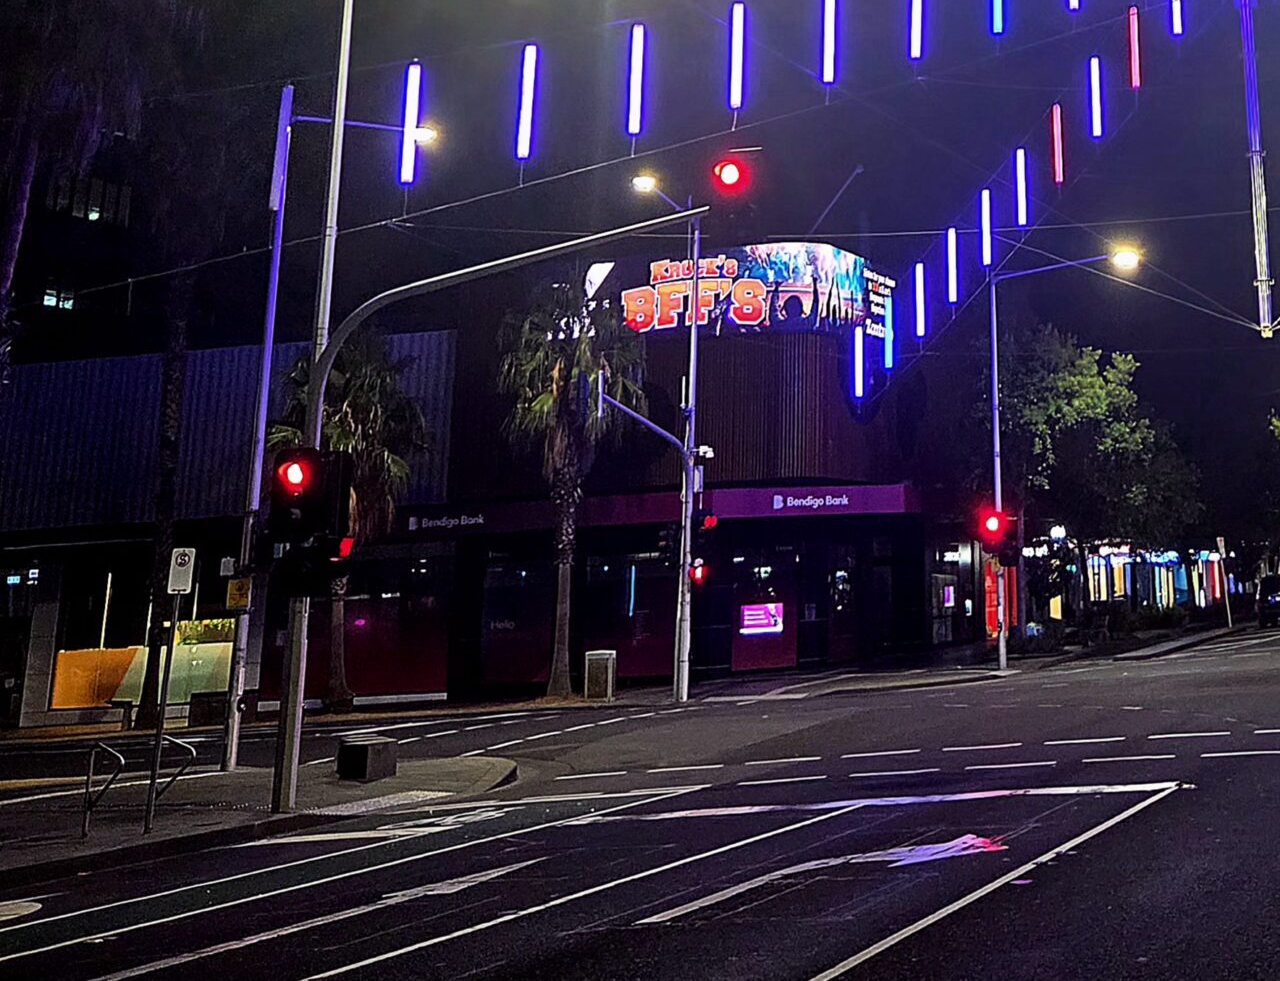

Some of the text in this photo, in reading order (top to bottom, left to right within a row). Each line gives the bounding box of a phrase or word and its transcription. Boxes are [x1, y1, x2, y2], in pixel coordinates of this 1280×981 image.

[621, 278, 767, 333] BFF'S
[786, 495, 825, 509] Bendigo
[825, 494, 849, 506] Bank
[421, 516, 460, 529] Bendigo
[460, 514, 485, 526] Bank
